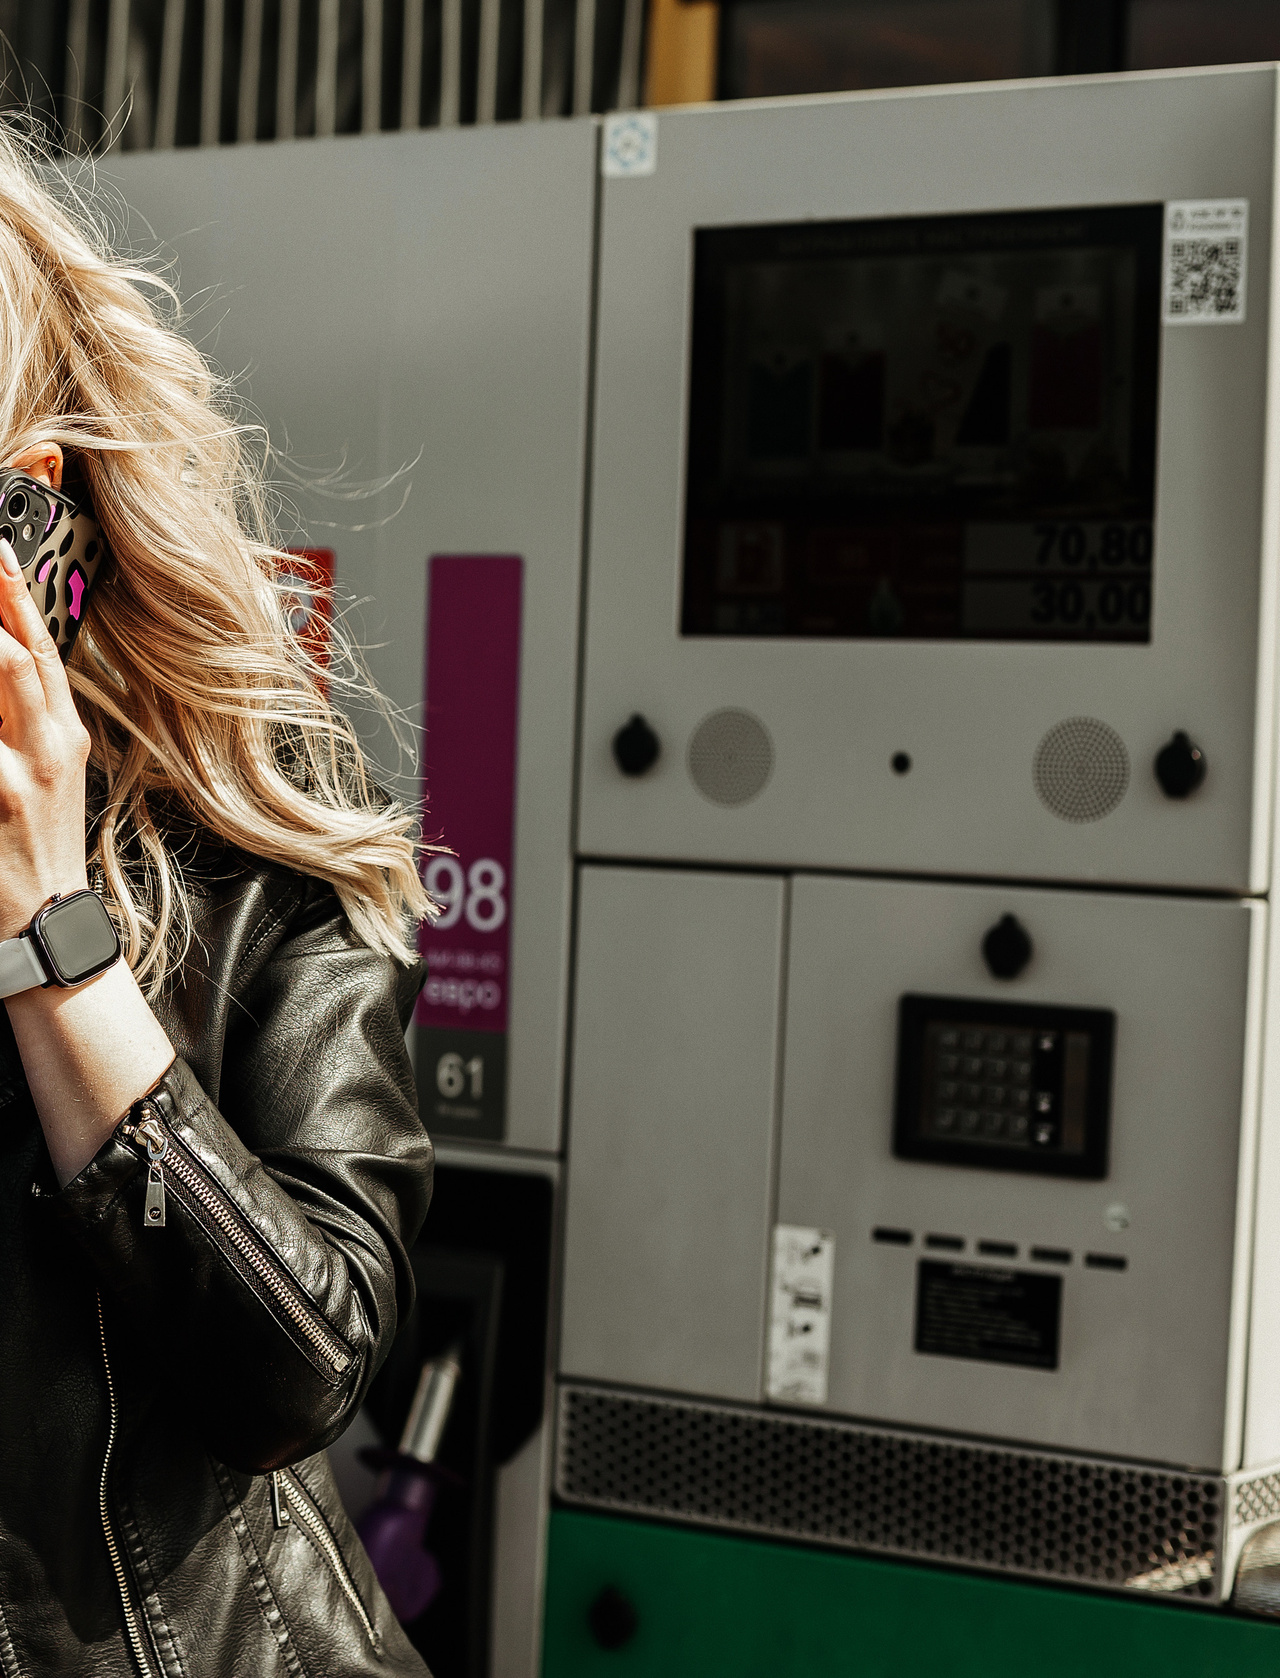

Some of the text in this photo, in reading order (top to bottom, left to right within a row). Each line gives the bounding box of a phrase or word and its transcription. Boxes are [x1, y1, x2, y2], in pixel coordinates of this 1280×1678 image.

[1032, 525, 1151, 572] 70,80
[1030, 580, 1150, 631] 30,00
[424, 856, 507, 932] 98
[436, 1052, 485, 1100] 61
